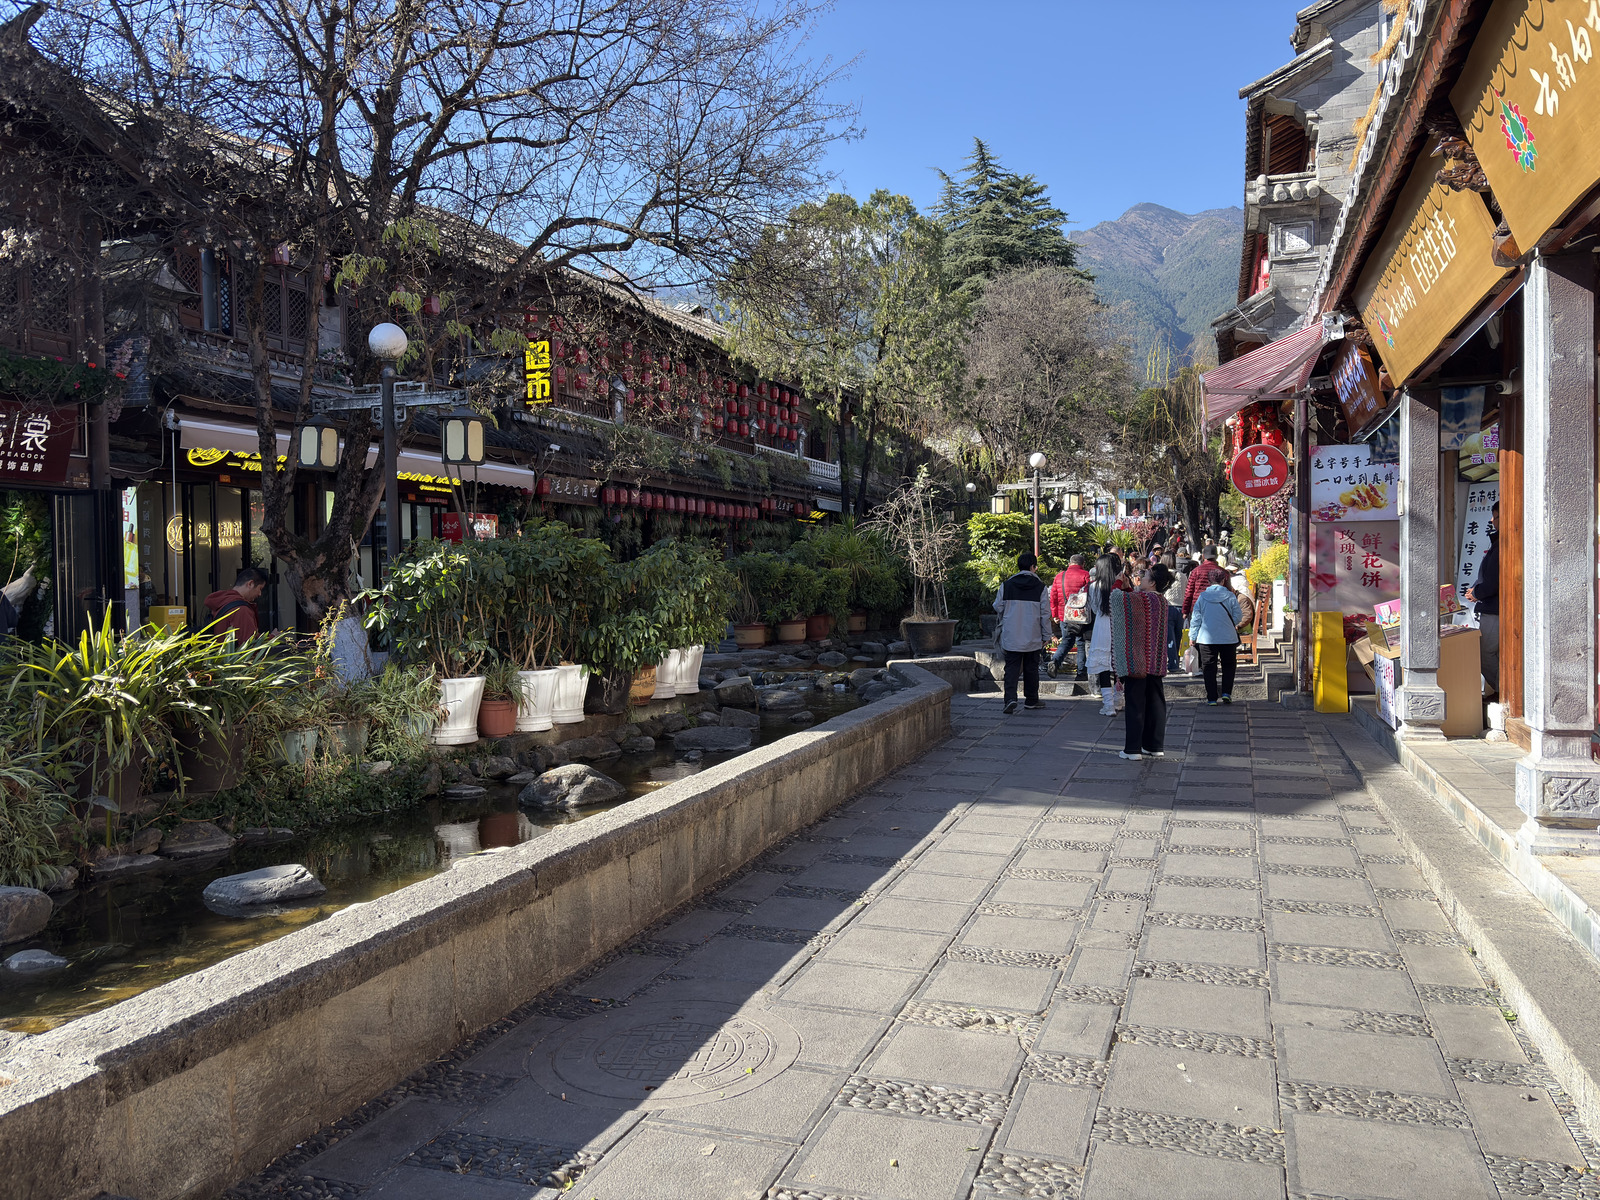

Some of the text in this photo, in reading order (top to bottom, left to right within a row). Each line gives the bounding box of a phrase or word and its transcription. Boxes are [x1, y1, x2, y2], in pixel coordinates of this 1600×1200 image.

[525, 340, 551, 399] 超市
[0, 450, 46, 460] PEACOCK
[1471, 452, 1496, 464] 云南
[1245, 477, 1278, 488] 蜜雪冰城
[1320, 472, 1399, 486] 一口吃到真鲜
[1469, 489, 1499, 503] 云南特
[1340, 529, 1356, 555] 玫瑰
[1361, 533, 1383, 588] 鲜花饼
